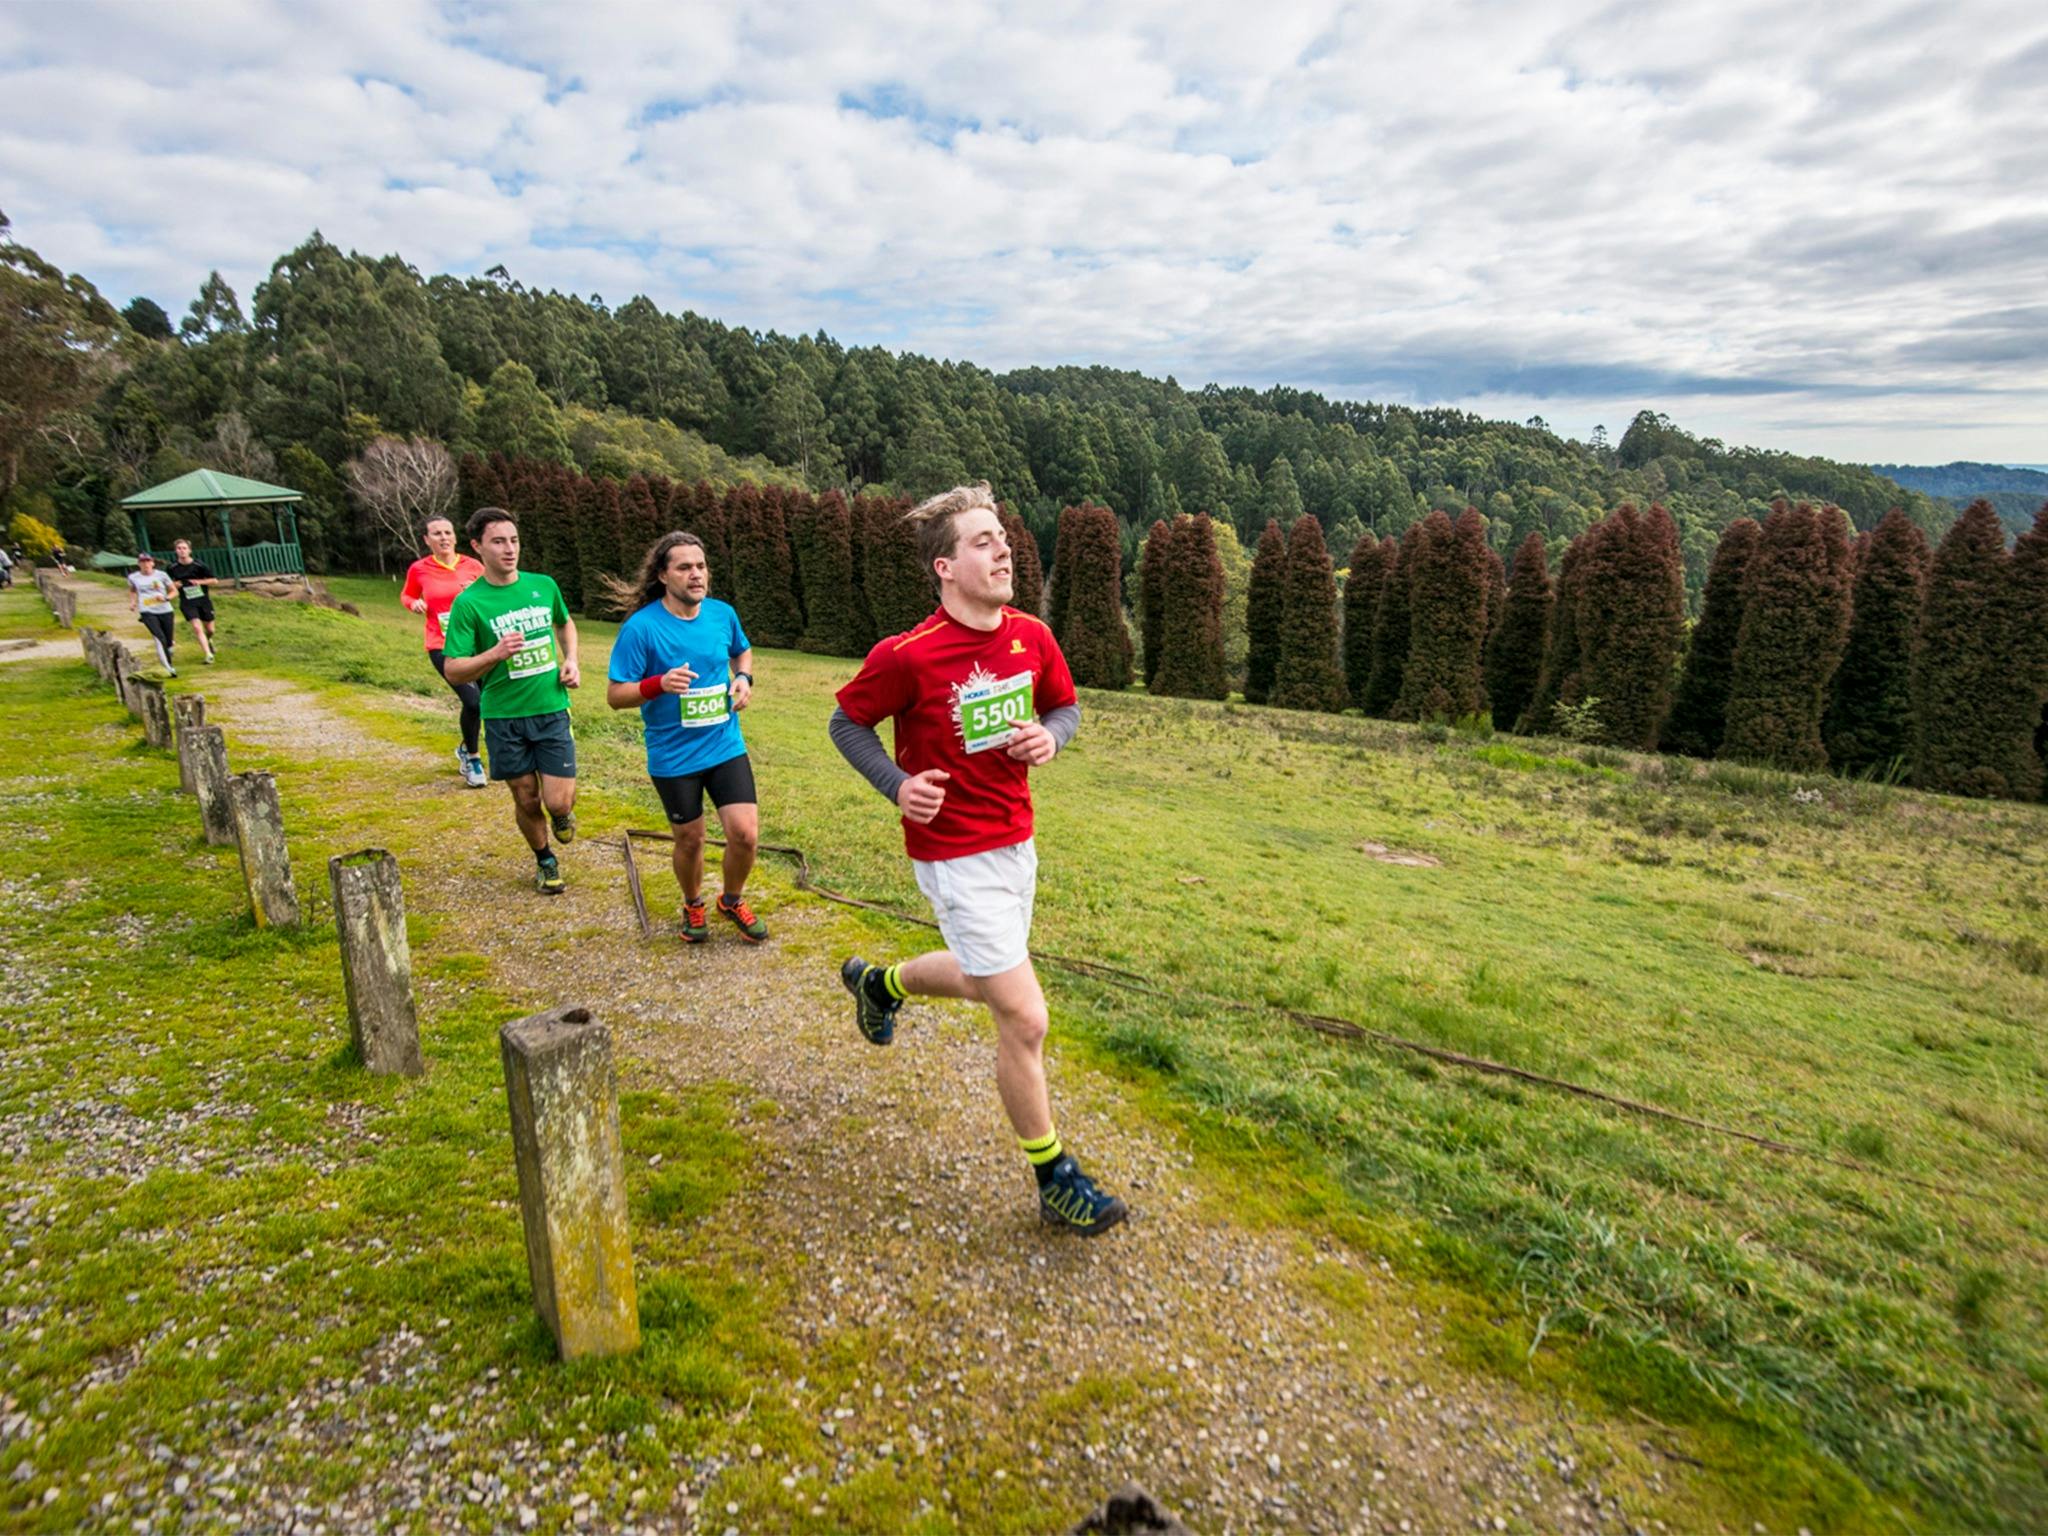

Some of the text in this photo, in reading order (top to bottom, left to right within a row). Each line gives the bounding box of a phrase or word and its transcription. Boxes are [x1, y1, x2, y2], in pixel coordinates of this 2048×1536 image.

[512, 648, 548, 667] 5515
[687, 696, 725, 715] 5604
[973, 694, 1025, 731] 5501
